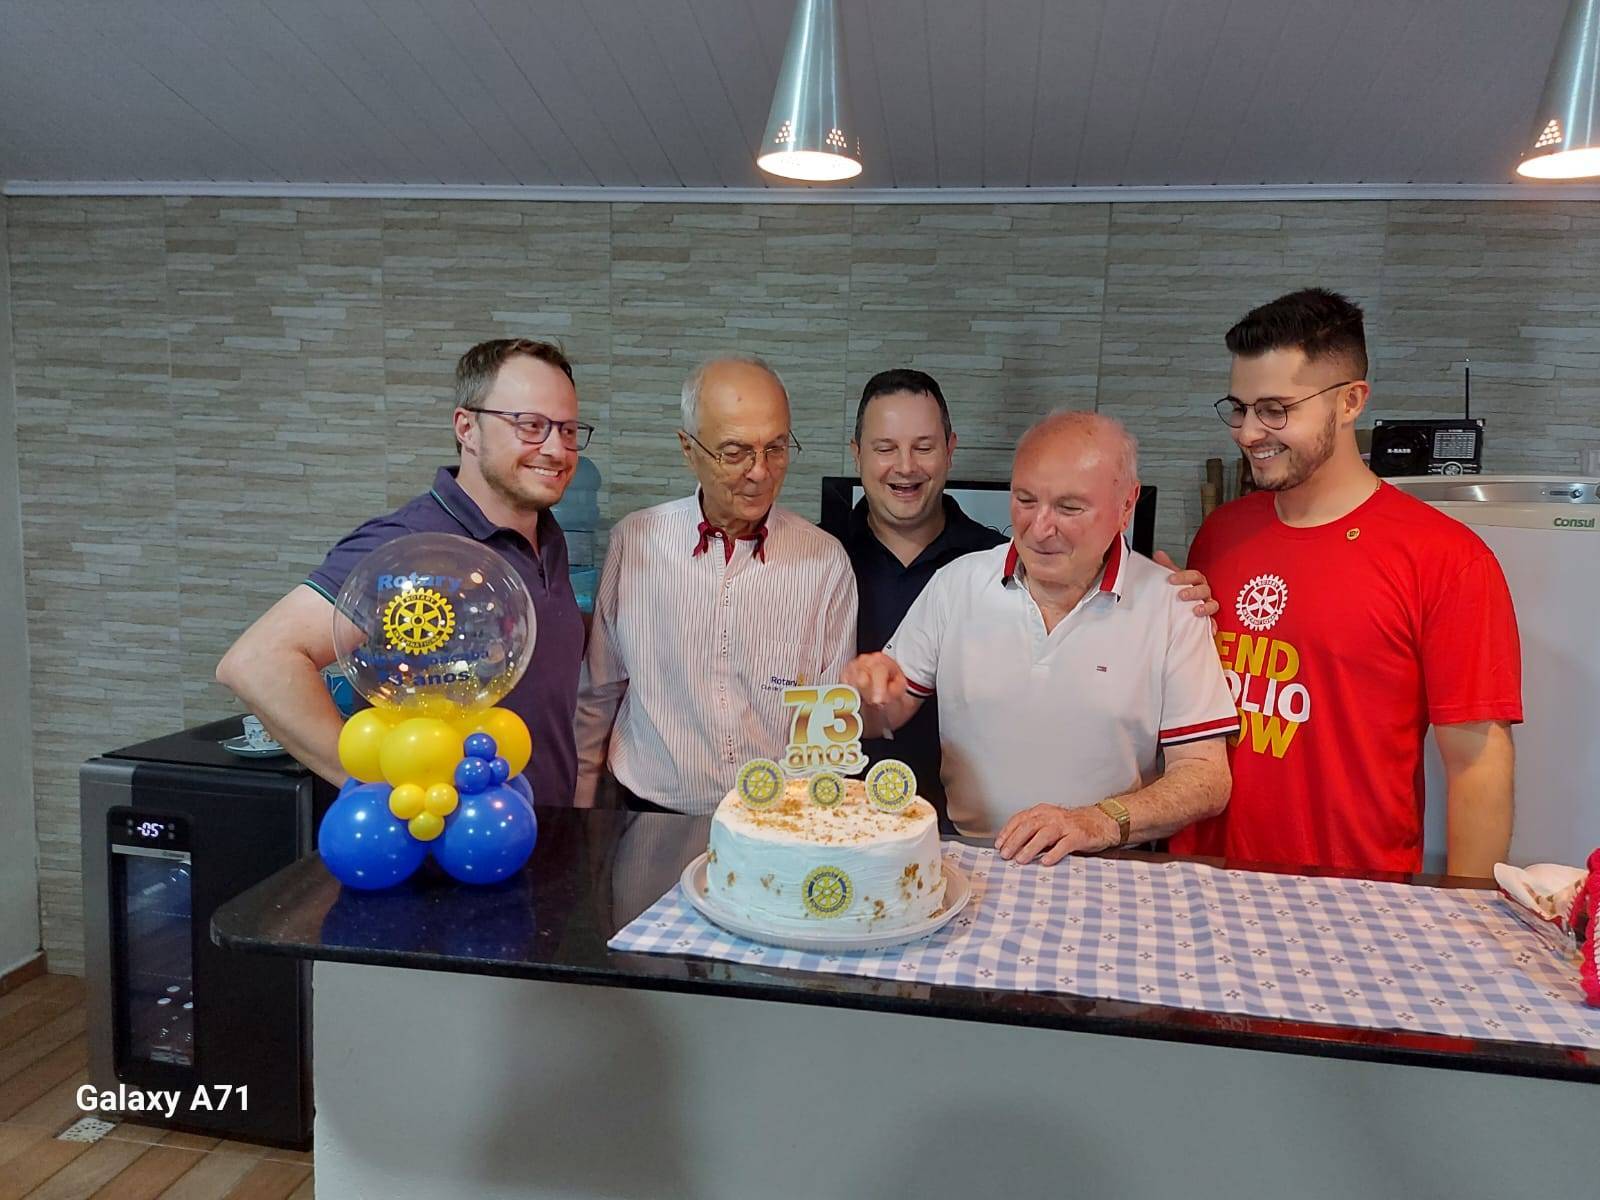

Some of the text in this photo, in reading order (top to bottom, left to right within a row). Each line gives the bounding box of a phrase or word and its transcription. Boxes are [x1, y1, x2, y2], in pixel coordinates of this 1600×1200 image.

[1553, 517, 1596, 528] Consul
[377, 573, 463, 592] Rotary
[1216, 631, 1300, 682] END
[414, 670, 470, 687] anos
[771, 676, 798, 687] Rotary
[1223, 669, 1311, 723] OLIO
[783, 687, 860, 744] 73
[788, 744, 859, 766] anos
